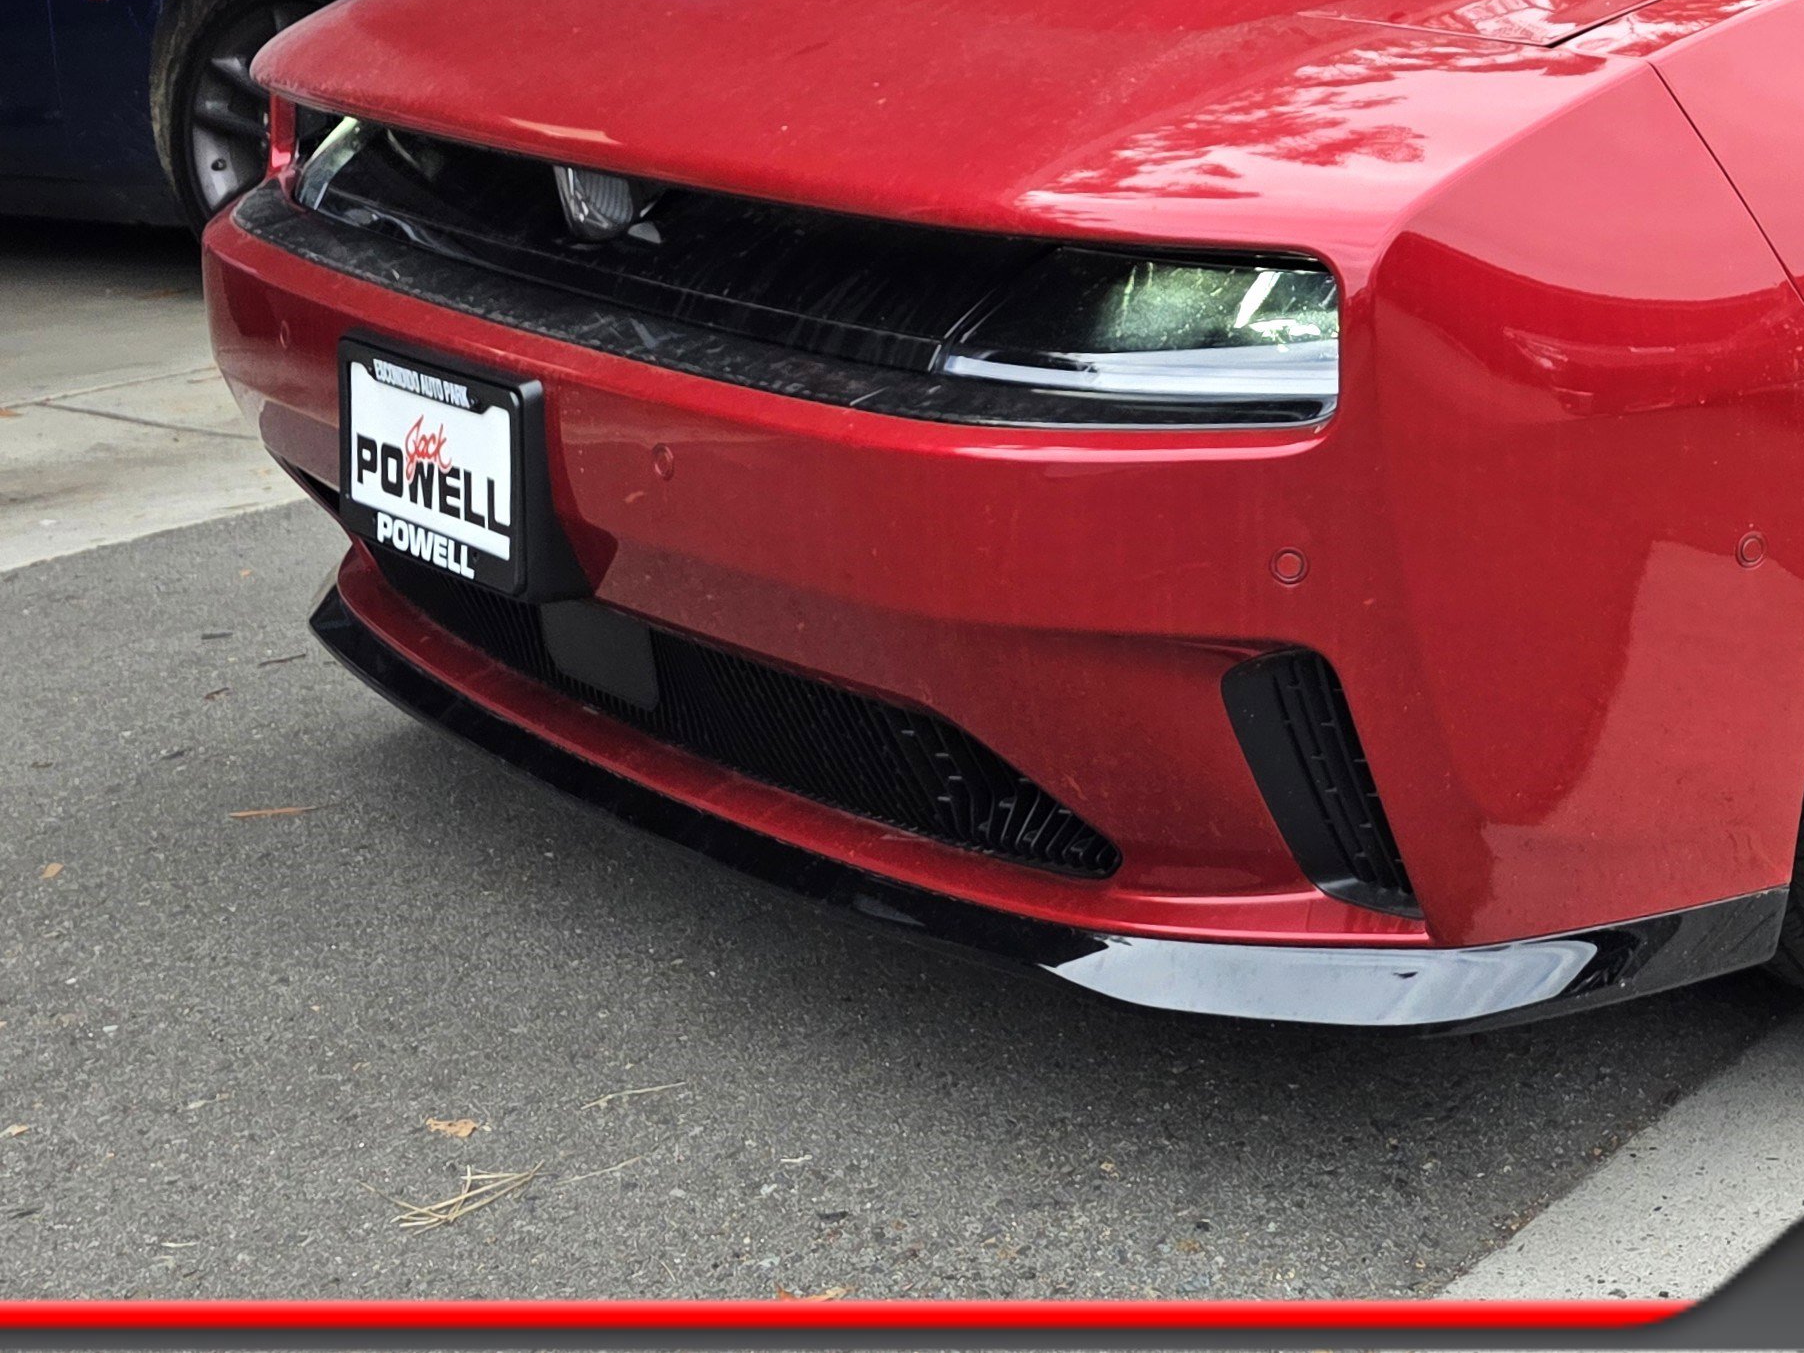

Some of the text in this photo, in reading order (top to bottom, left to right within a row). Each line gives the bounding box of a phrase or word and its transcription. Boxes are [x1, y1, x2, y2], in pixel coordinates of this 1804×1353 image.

[419, 373, 444, 401] AUTO
[443, 381, 471, 409] PARK
[404, 414, 452, 481] Jack
[356, 433, 511, 536] POWELL
[376, 511, 475, 580] POWELL
